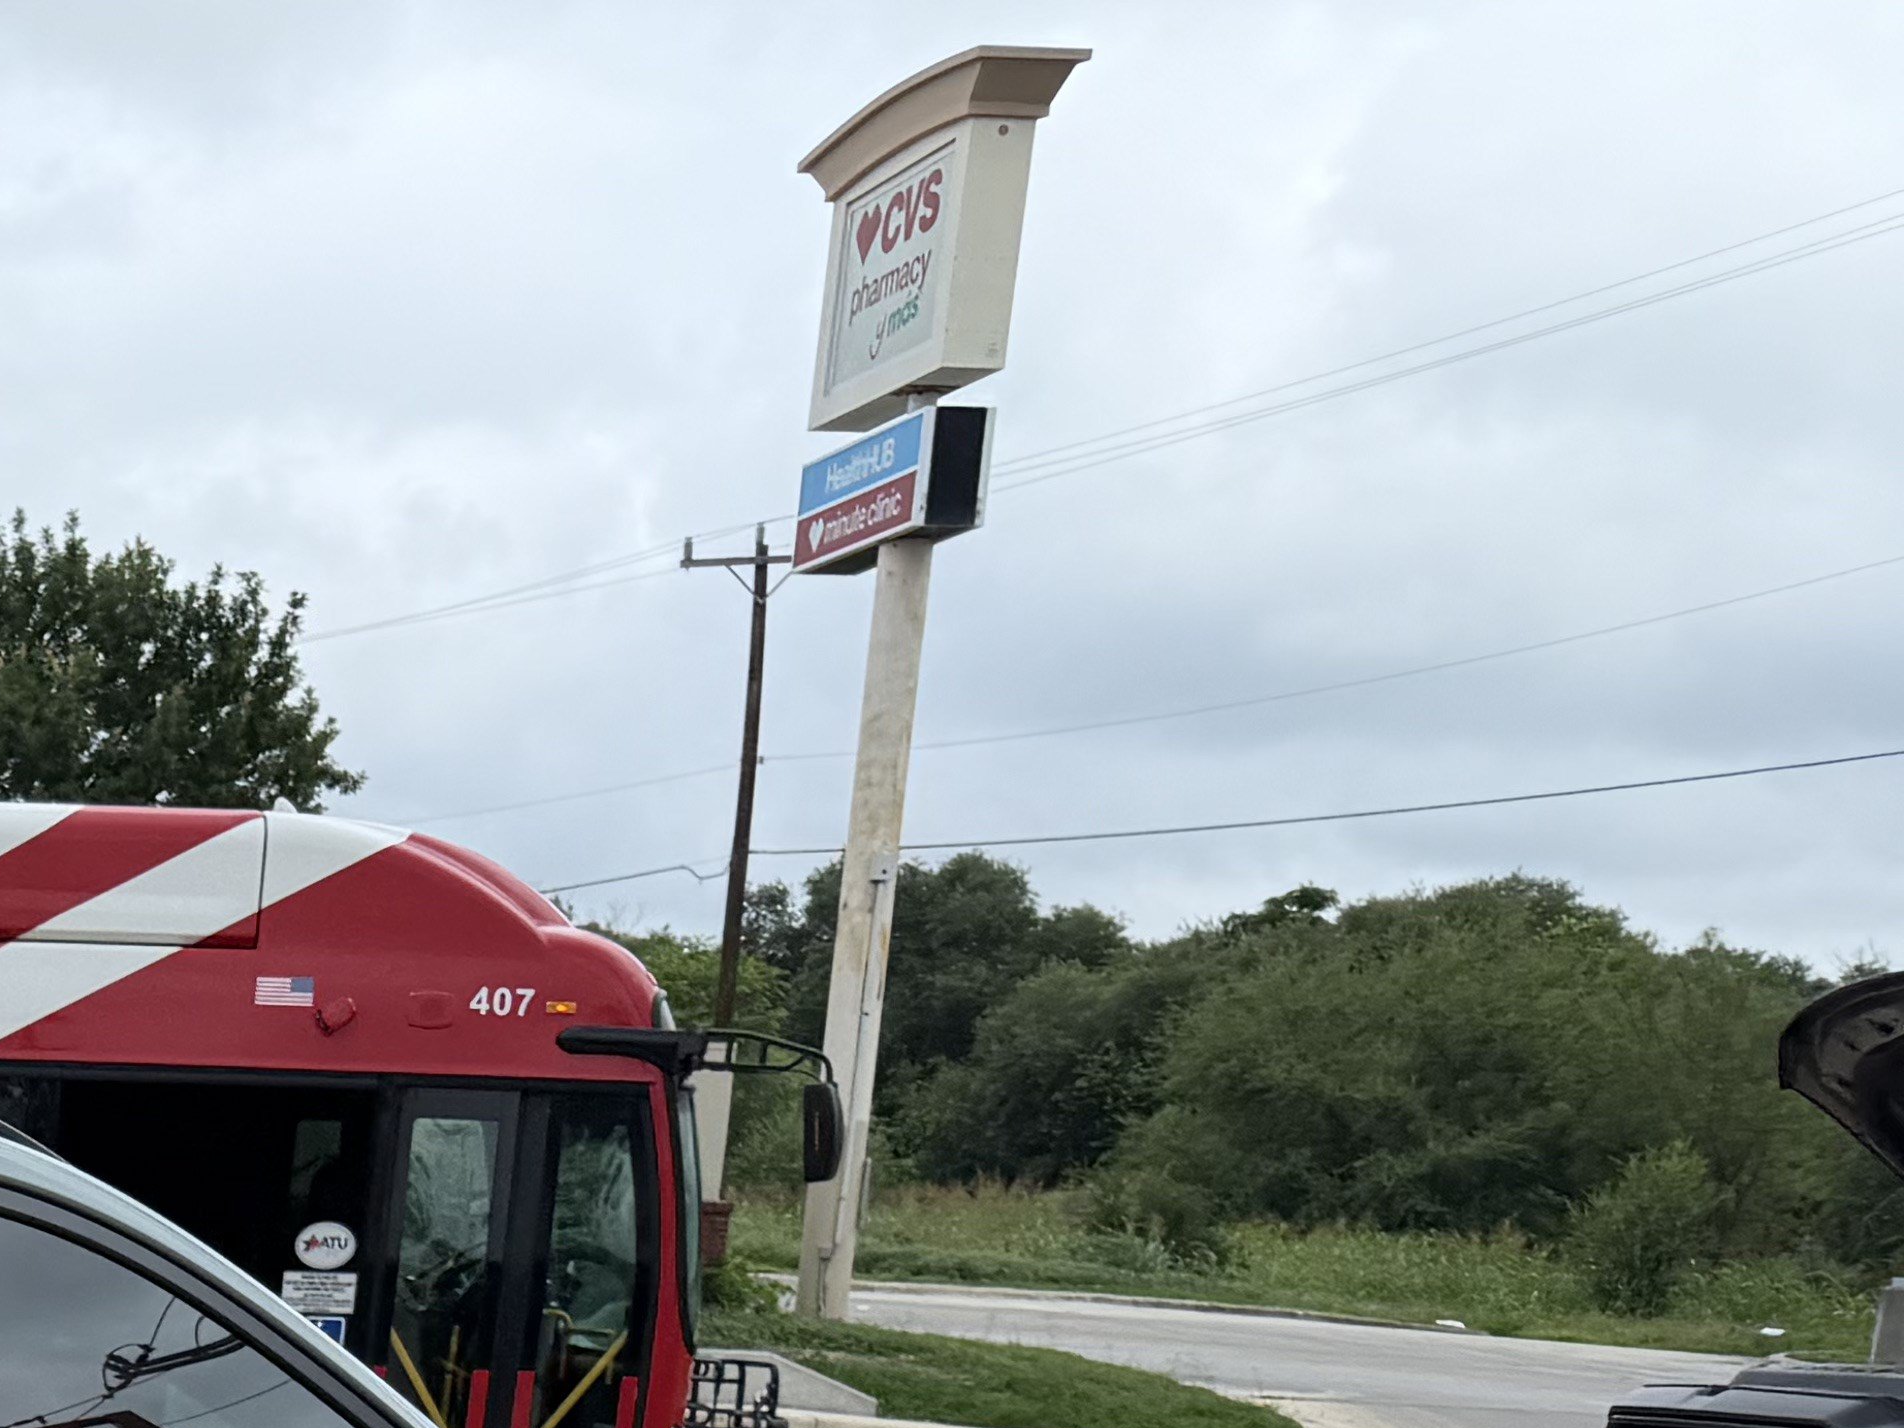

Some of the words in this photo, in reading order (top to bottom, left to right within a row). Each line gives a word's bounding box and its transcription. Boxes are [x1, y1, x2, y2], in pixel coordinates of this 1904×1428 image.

[881, 168, 943, 254] CVS
[849, 249, 932, 327] pharmacy
[869, 314, 888, 360] y
[824, 504, 867, 544] minute
[867, 489, 902, 525] clinic
[470, 987, 536, 1017] 407
[321, 1236, 349, 1250] ATU
